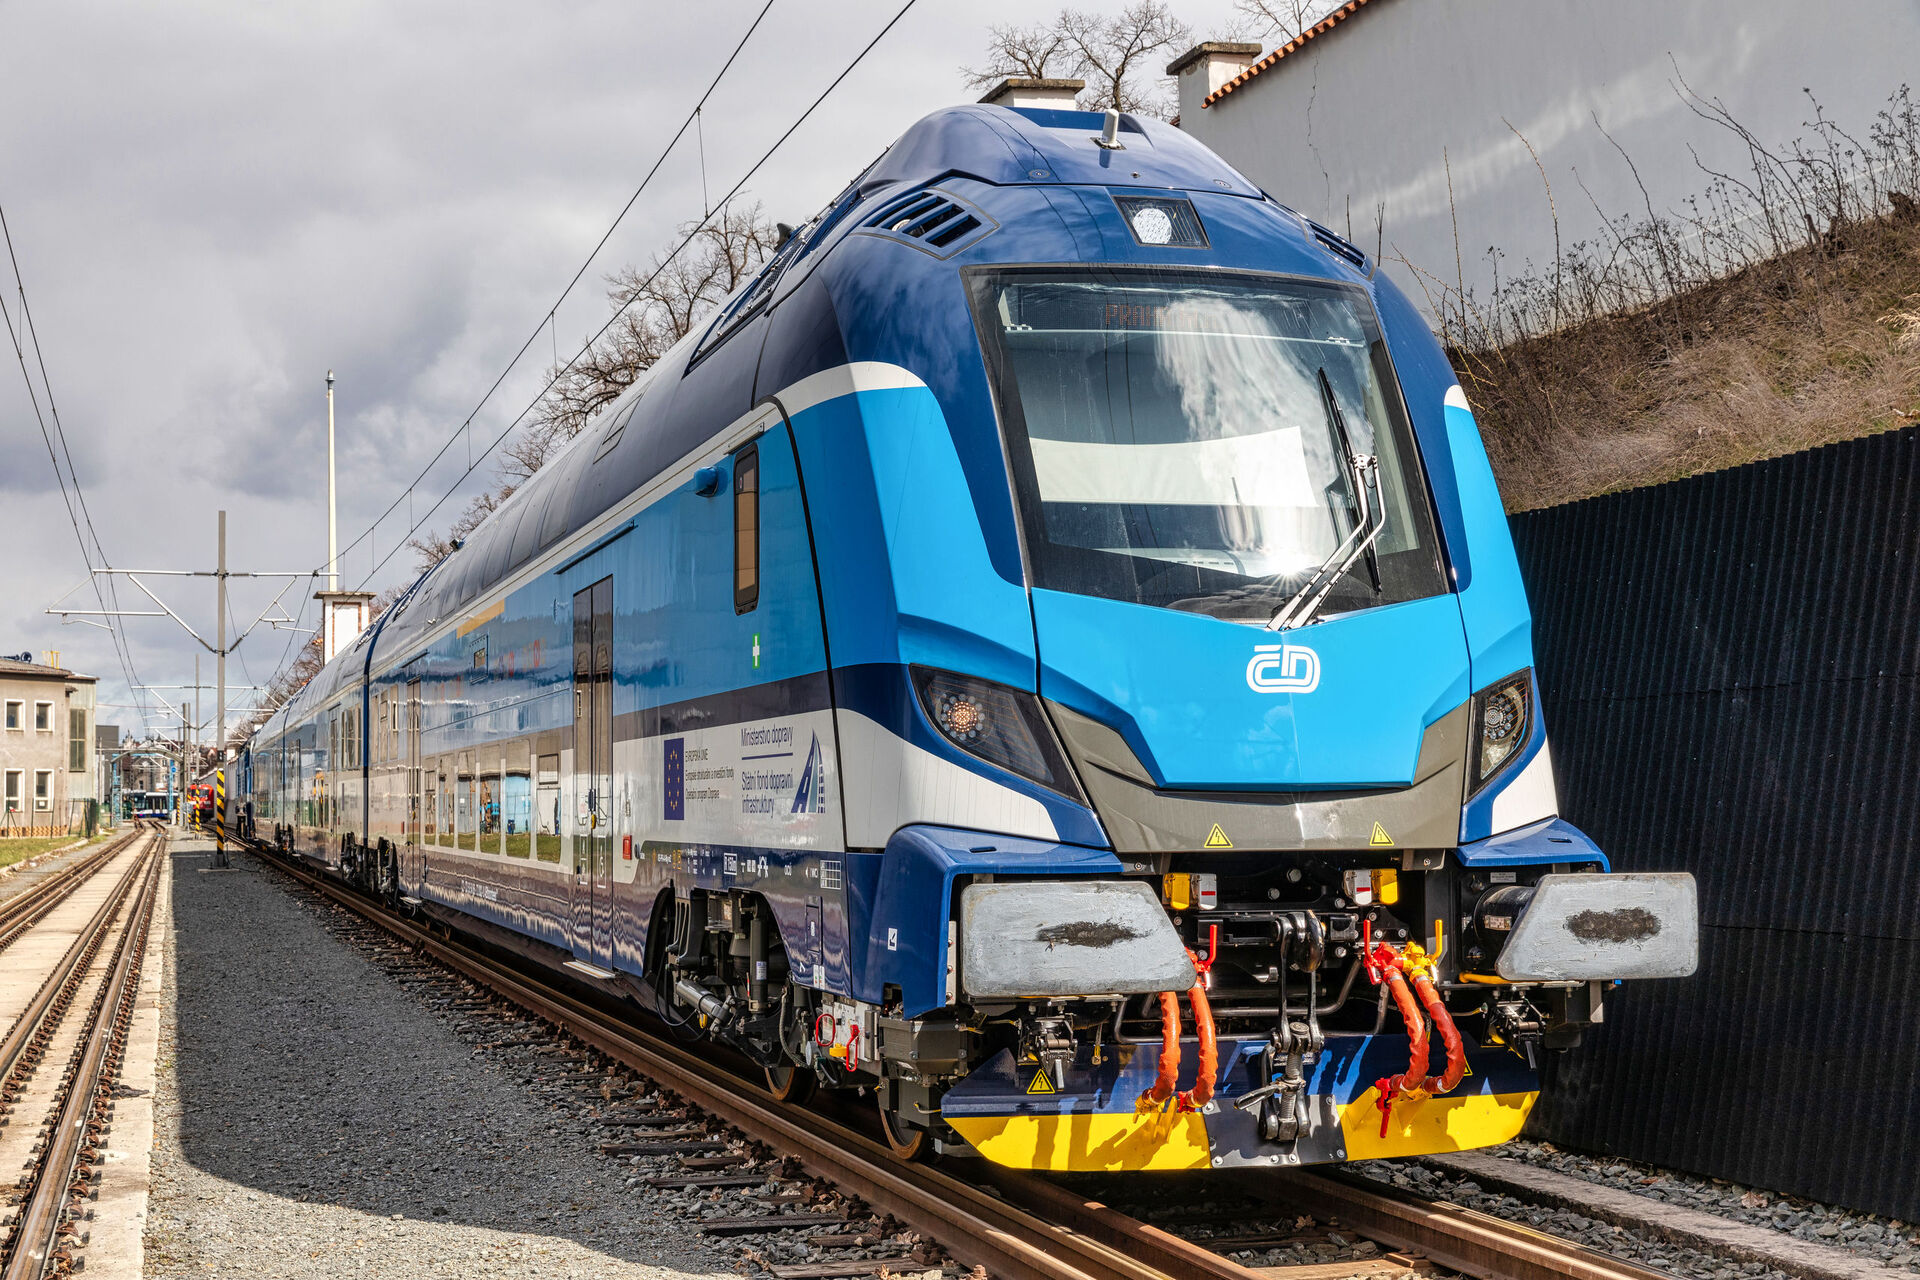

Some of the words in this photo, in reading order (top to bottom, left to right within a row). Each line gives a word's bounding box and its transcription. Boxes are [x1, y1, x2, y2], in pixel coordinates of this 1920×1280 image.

[741, 726, 770, 746] Ministerstvo
[771, 724, 794, 747] dopravy
[757, 770, 768, 790] fond
[769, 768, 794, 793] dopravní
[741, 794, 775, 818] infrastruktury
